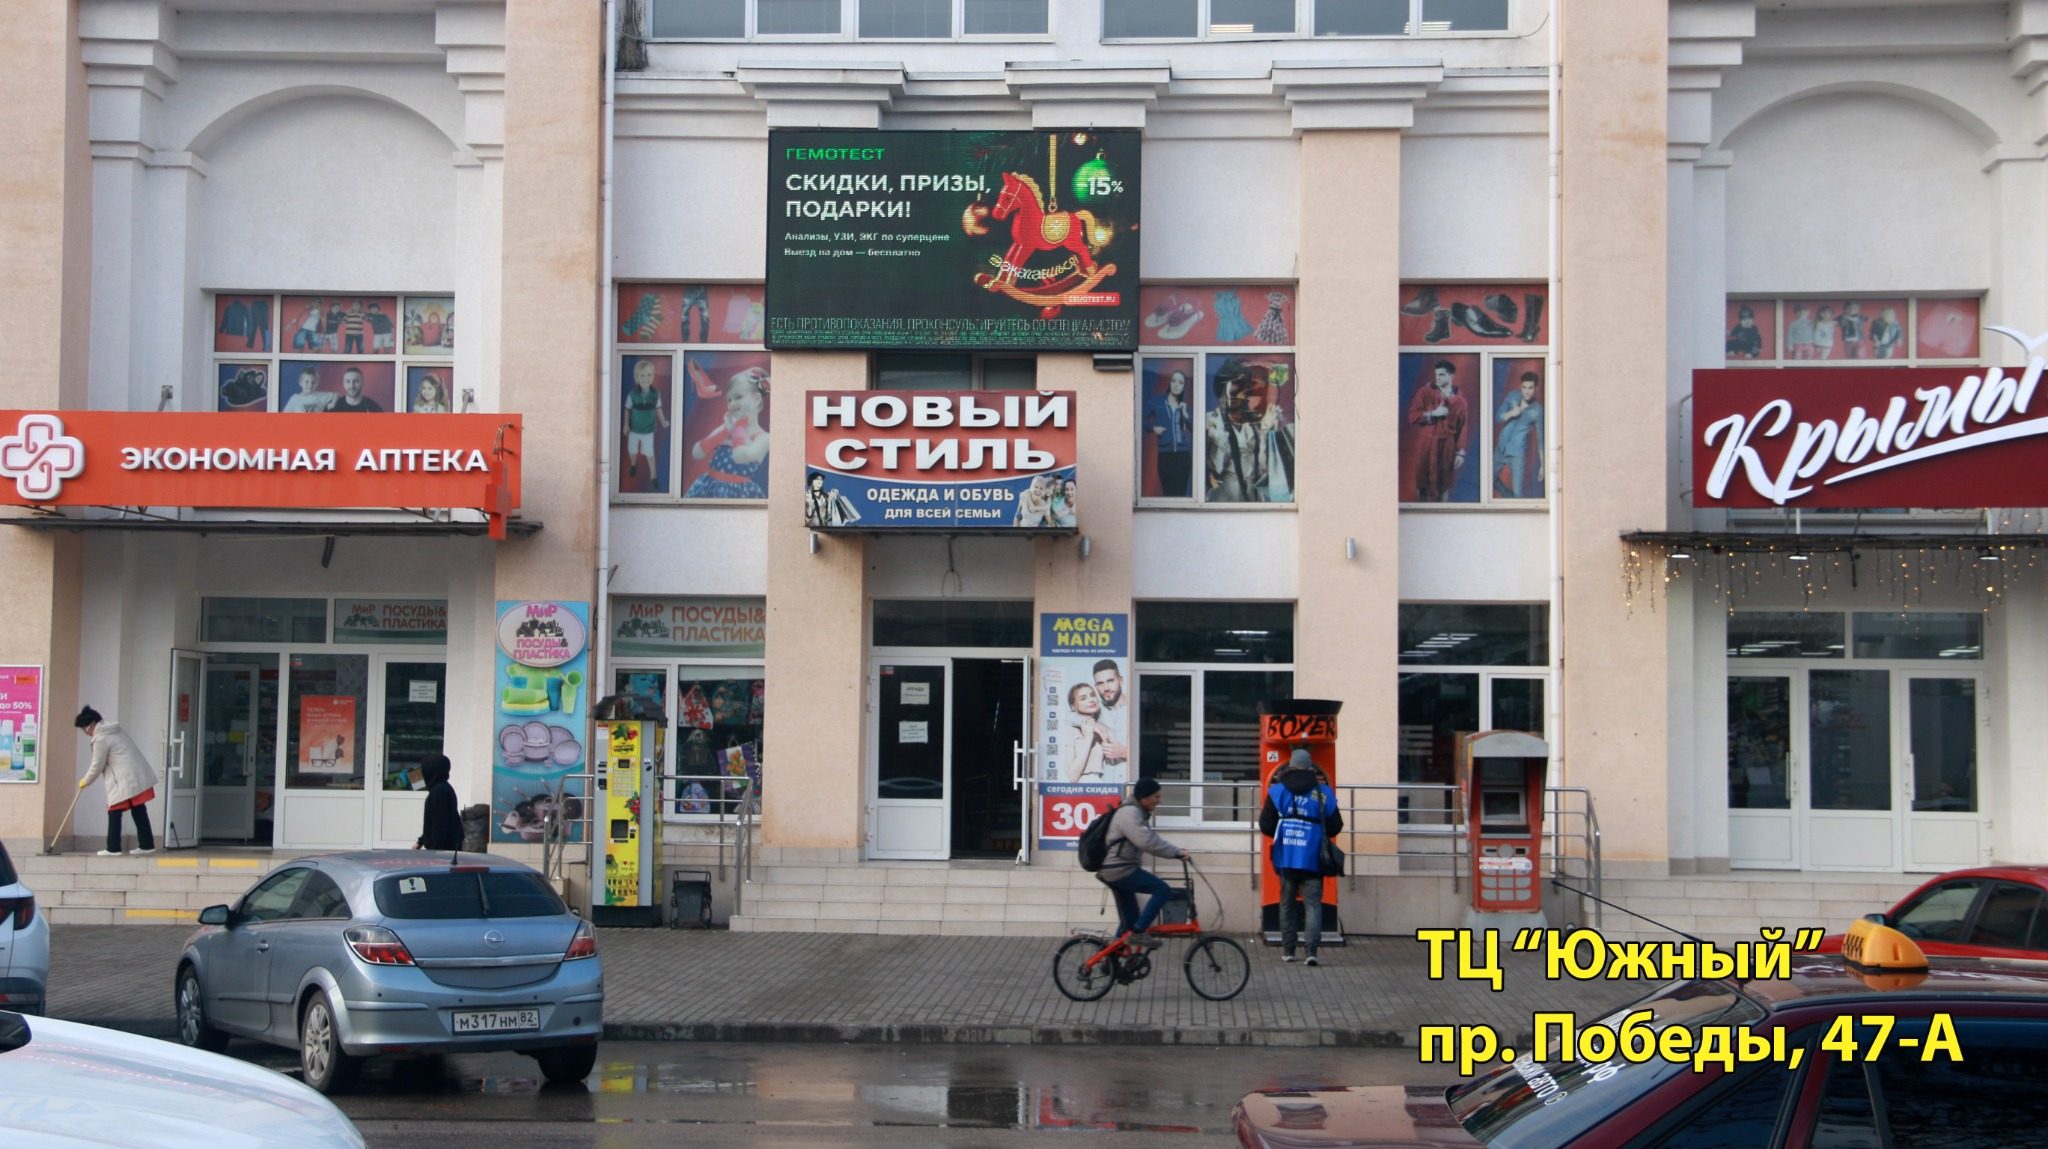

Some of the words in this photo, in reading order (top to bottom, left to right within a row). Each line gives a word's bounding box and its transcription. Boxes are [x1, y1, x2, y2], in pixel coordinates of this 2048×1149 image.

[785, 148, 886, 161] ГЕМОТЕСТ
[785, 174, 894, 195] СКИДКИ,
[899, 174, 992, 194] ПРИЗЫ,
[785, 200, 912, 219] ПОДАРКИ!
[784, 232, 831, 243] Анализы,
[834, 232, 857, 243] УЗИ,
[860, 233, 879, 242] ЭКГ
[881, 234, 894, 242] по
[896, 234, 950, 243] суперцене
[784, 248, 817, 258] Выезд
[833, 249, 853, 258] дом
[868, 248, 921, 257] бесплатно
[770, 317, 794, 330] ЕСТЬ
[813, 391, 1068, 428] НОВЫЙ
[121, 446, 336, 471] ЭКОНОМНАЯ
[355, 448, 490, 471] АПТЕКА
[825, 438, 1056, 470] СТИЛЬ
[867, 488, 937, 503] ОДЕЖДА
[943, 489, 955, 501] И
[960, 488, 1015, 502] ОБУВЬ
[884, 509, 912, 520] ДЛЯ
[916, 507, 951, 519] ВСЕЙ
[955, 508, 1001, 519] СЕМЬИ
[383, 618, 446, 629] ПЛАСТИКА
[672, 626, 765, 642] ПЛАСТИКА
[1056, 631, 1110, 647] HAND
[513, 648, 571, 659] ПЛАСТИКА
[1267, 714, 1336, 739] BOXER
[1046, 785, 1084, 794] сегодня
[1085, 785, 1119, 794] скидка
